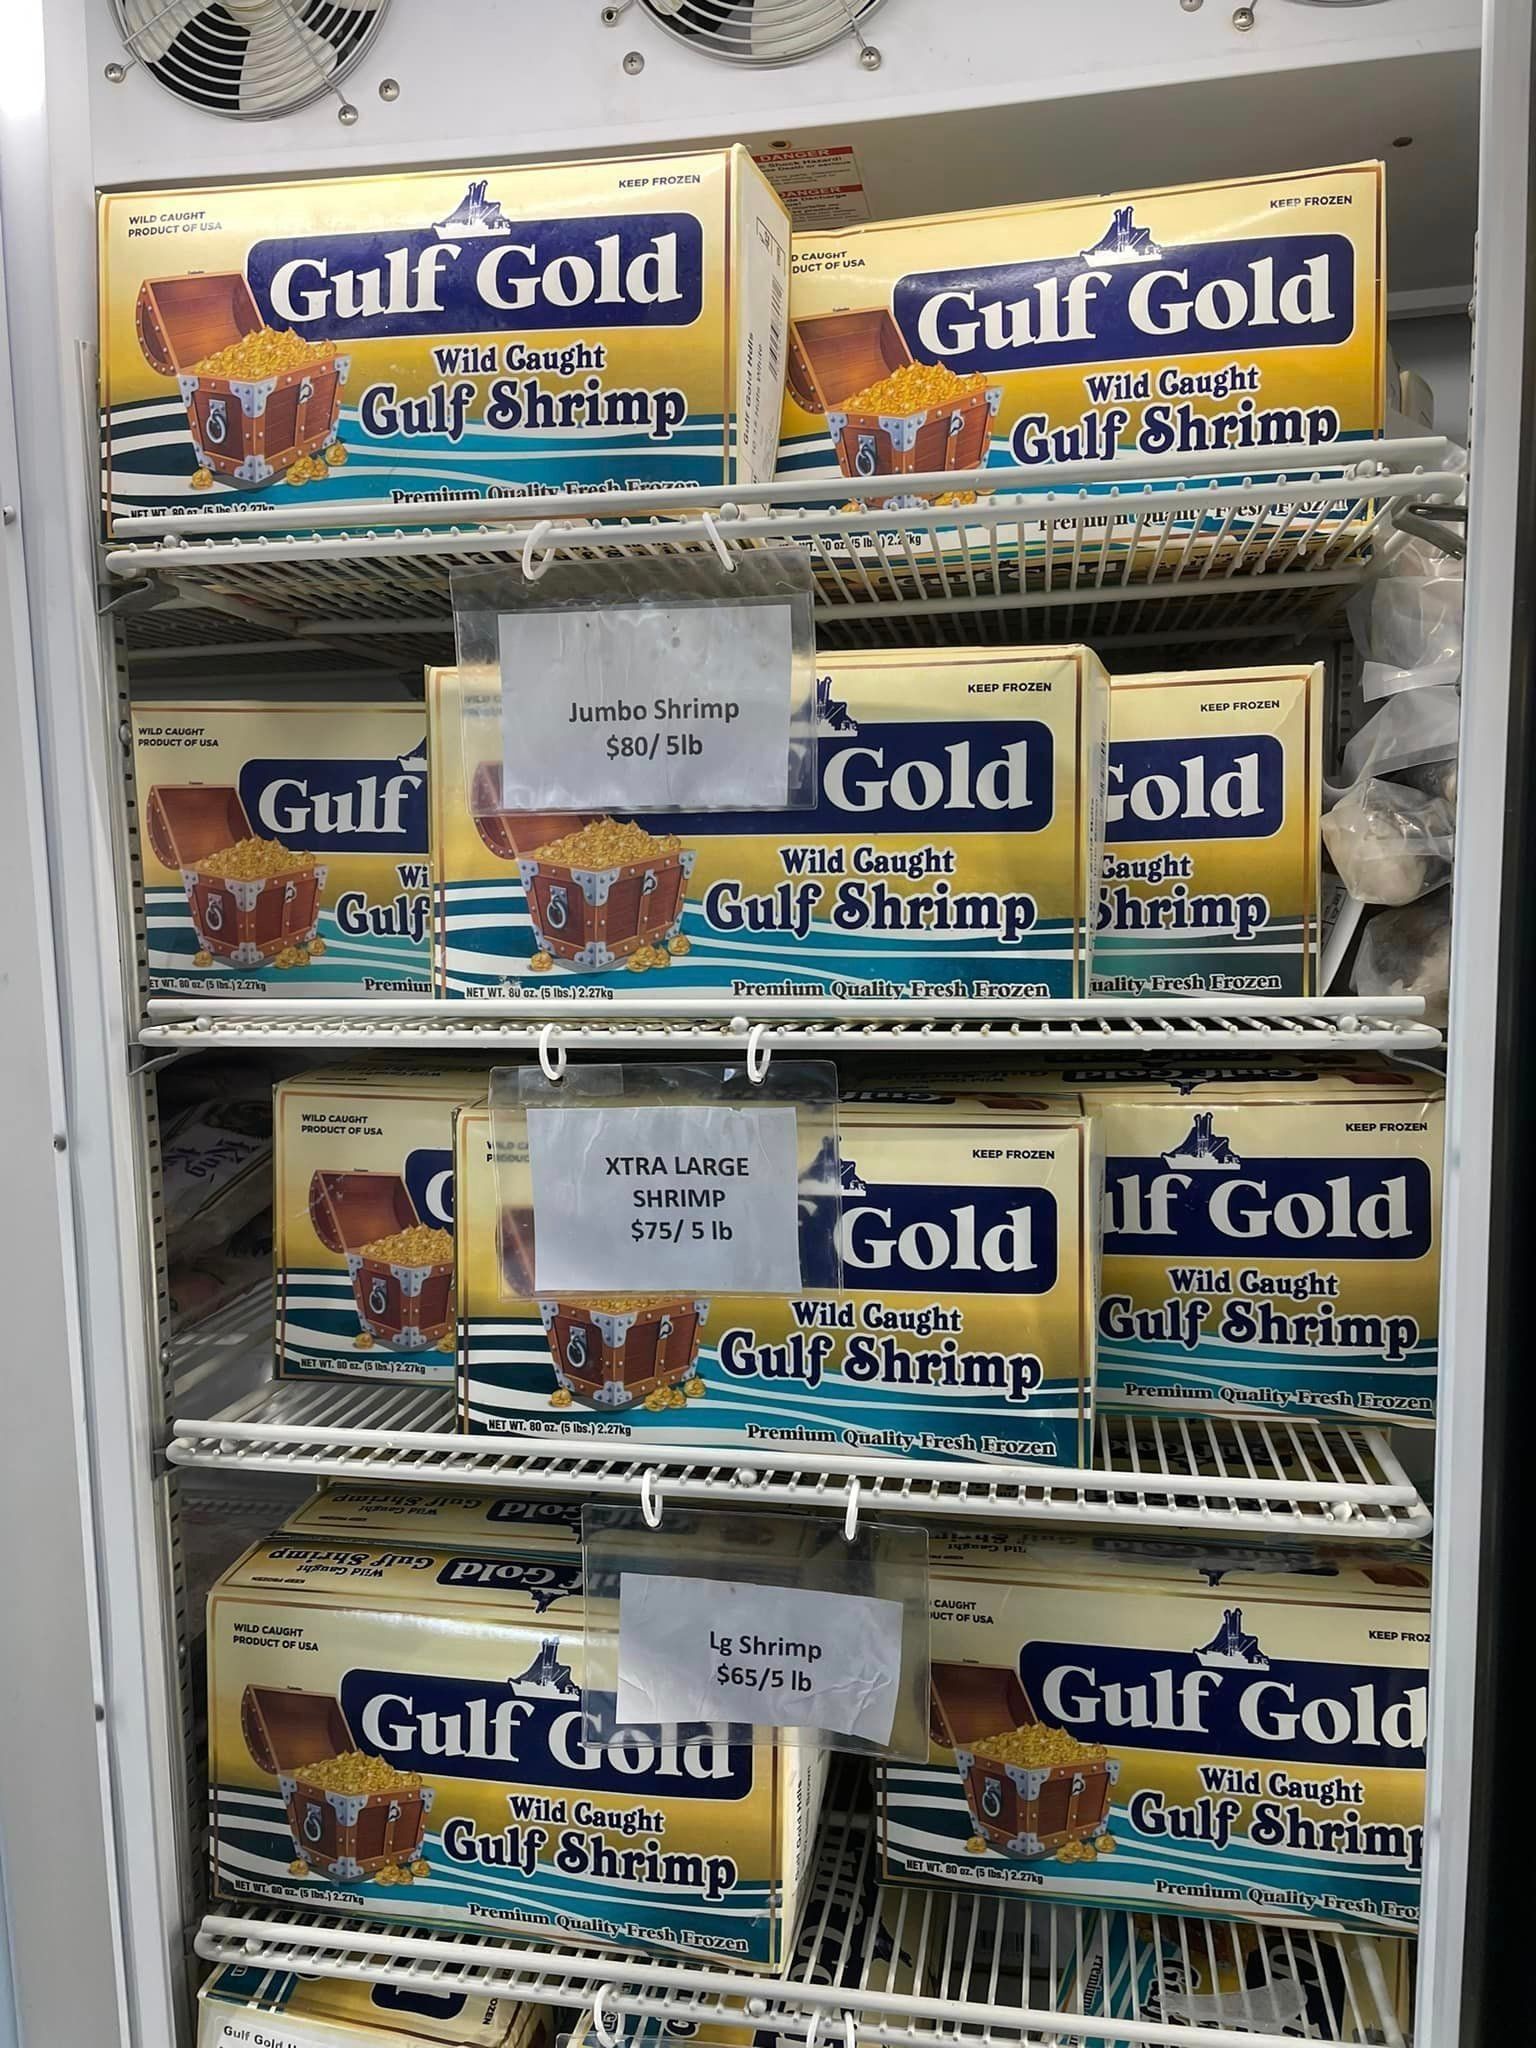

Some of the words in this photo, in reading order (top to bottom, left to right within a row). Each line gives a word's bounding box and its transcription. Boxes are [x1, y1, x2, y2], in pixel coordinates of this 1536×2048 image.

[760, 149, 830, 161] DANGER
[618, 178, 649, 189] KEEP
[652, 174, 700, 187] FROZEN
[1270, 198, 1301, 209] KEEP
[1304, 194, 1352, 206] FROZEN
[128, 225, 179, 237] PRODUCT
[182, 224, 197, 232] OF
[200, 222, 222, 230] USA
[129, 215, 157, 225] WILD
[160, 211, 206, 222] CAUGHT
[801, 251, 847, 261] CAUGHT
[843, 259, 865, 268] USA
[270, 243, 463, 322] Gulf
[476, 232, 683, 310] Gold
[917, 272, 1112, 356] Gulf
[1127, 254, 1335, 335] Gold
[435, 347, 497, 374] Wild
[506, 343, 605, 375] Caught
[1086, 373, 1150, 401] Wild
[1159, 366, 1258, 397] Caught
[361, 383, 476, 440] Gulf
[487, 379, 686, 436] Shrimp
[1012, 409, 1128, 465] Gulf
[1139, 400, 1337, 454] Shrimp
[968, 683, 999, 693] KEEP
[1003, 682, 1052, 692] FROZEN
[569, 700, 647, 723] Jumbo
[654, 698, 739, 723] Shrimp
[1200, 702, 1230, 712] KEEP
[1234, 700, 1280, 711] FROZEN
[138, 739, 182, 747] PRODUCT
[184, 739, 197, 747] OF
[200, 739, 219, 747] USA
[139, 728, 162, 736] WILD
[165, 728, 205, 736] CAUGHT
[606, 733, 660, 760] $80/
[666, 733, 703, 756] 5lb
[823, 740, 1033, 812] Gold
[259, 775, 422, 833] Gulf
[781, 848, 844, 873] Wild
[854, 848, 954, 878] Caught
[1102, 854, 1190, 882] Caught
[397, 866, 429, 888] Wi
[337, 893, 430, 943] Gulf
[706, 883, 822, 938] Gulf
[833, 883, 1035, 941] Shrimp
[466, 988, 484, 998] NET
[486, 988, 505, 998] WT.
[508, 988, 520, 998] 80
[523, 989, 538, 998] oz.
[541, 988, 551, 999] (5
[554, 987, 576, 999] lbs.)
[579, 988, 613, 999] 2.27kg
[733, 980, 824, 997] Premium
[831, 980, 903, 999] Quality
[911, 980, 967, 997] Fresh
[974, 981, 1049, 998] Frozen
[1092, 977, 1145, 994] uality
[1152, 974, 1203, 990] Fresh
[1211, 975, 1280, 989] Frozen
[301, 1125, 345, 1134] PRODUCT
[348, 1126, 361, 1135] OF
[364, 1127, 383, 1135] USA
[302, 1114, 326, 1122] WILD
[329, 1115, 368, 1124] CAUGHT
[1345, 1123, 1376, 1132] KEEP
[1380, 1122, 1427, 1131] FROZEN
[605, 1156, 668, 1176] XTRA
[675, 1157, 749, 1176] LARGE
[972, 1149, 1003, 1158] KEEP
[1006, 1150, 1055, 1159] FROZEN
[633, 1189, 725, 1208] SHRIMP
[1208, 1175, 1413, 1239] Gold
[631, 1218, 684, 1243] $75/
[692, 1221, 704, 1240] 5
[712, 1220, 733, 1241] lb
[834, 1204, 1037, 1272] Gold
[1169, 1269, 1231, 1293] Wild
[1239, 1270, 1338, 1297] Caught
[792, 1301, 853, 1328] Wild
[863, 1303, 962, 1336] Caught
[1099, 1297, 1209, 1348] Gulf
[1222, 1300, 1418, 1359] Shrimp
[720, 1332, 833, 1386] Gulf
[845, 1336, 1041, 1400] Shrimp
[1125, 1383, 1212, 1399] Premium
[1220, 1387, 1290, 1406] Quality
[1297, 1391, 1351, 1406] Fresh
[1360, 1393, 1432, 1410] Frozen
[489, 1419, 506, 1429] NET
[509, 1420, 527, 1430] WT.
[530, 1422, 541, 1431] 80
[544, 1424, 558, 1432] oz.
[561, 1422, 570, 1434] (5
[574, 1423, 595, 1435] lbs.)
[598, 1424, 631, 1436] 2.27kg
[747, 1424, 835, 1442] Premium
[843, 1430, 913, 1451] Quality
[921, 1433, 975, 1450] Fresh
[982, 1437, 1056, 1456] Frozen
[268, 1548, 369, 1567] Shrimp
[369, 1554, 434, 1570] Gulf
[296, 1564, 349, 1577] Caught
[350, 1566, 384, 1578] Wild
[449, 1561, 556, 1587] Gold
[934, 1600, 976, 1610] CAUGHT
[234, 1623, 259, 1633] WILD
[262, 1625, 303, 1638] CAUGHT
[956, 1613, 970, 1622] OF
[973, 1615, 994, 1624] USA
[233, 1635, 278, 1648] PRODUCT
[281, 1639, 296, 1649] OF
[298, 1640, 319, 1651] USA
[710, 1631, 732, 1656] Lg
[739, 1635, 822, 1663] Shrimp
[1369, 1630, 1398, 1641] KEEP
[1401, 1632, 1430, 1642] FROZ
[717, 1663, 784, 1691] $65/5
[792, 1671, 812, 1691] lb
[1042, 1665, 1224, 1733] Gulf
[1239, 1681, 1428, 1748] Gold
[361, 1693, 534, 1763] Gulf
[548, 1711, 735, 1779] Gold
[1200, 1768, 1260, 1795] Wild
[1269, 1773, 1363, 1804] Caught
[510, 1796, 567, 1823] Wild
[574, 1803, 664, 1835] Caught
[1131, 1792, 1240, 1848] Gulf
[444, 1819, 547, 1876] Gulf
[557, 1831, 736, 1899] Shrimp
[906, 1859, 923, 1870] NET
[926, 1861, 943, 1873] WT.
[960, 1867, 973, 1876] oz.
[976, 1866, 985, 1878] (5
[988, 1867, 1008, 1881] lbs.)
[1011, 1871, 1043, 1884] 2.27kg
[1156, 1880, 1241, 1900] Premium
[1248, 1888, 1315, 1908] Quality
[1322, 1896, 1382, 1913] Fresh
[469, 1904, 549, 1926] Premium
[557, 1914, 622, 1936] Quality
[627, 1923, 675, 1941] Fresh
[682, 1931, 748, 1951] Frozen
[224, 2026, 250, 2041] Gulf
[254, 2034, 284, 2048] Gold
